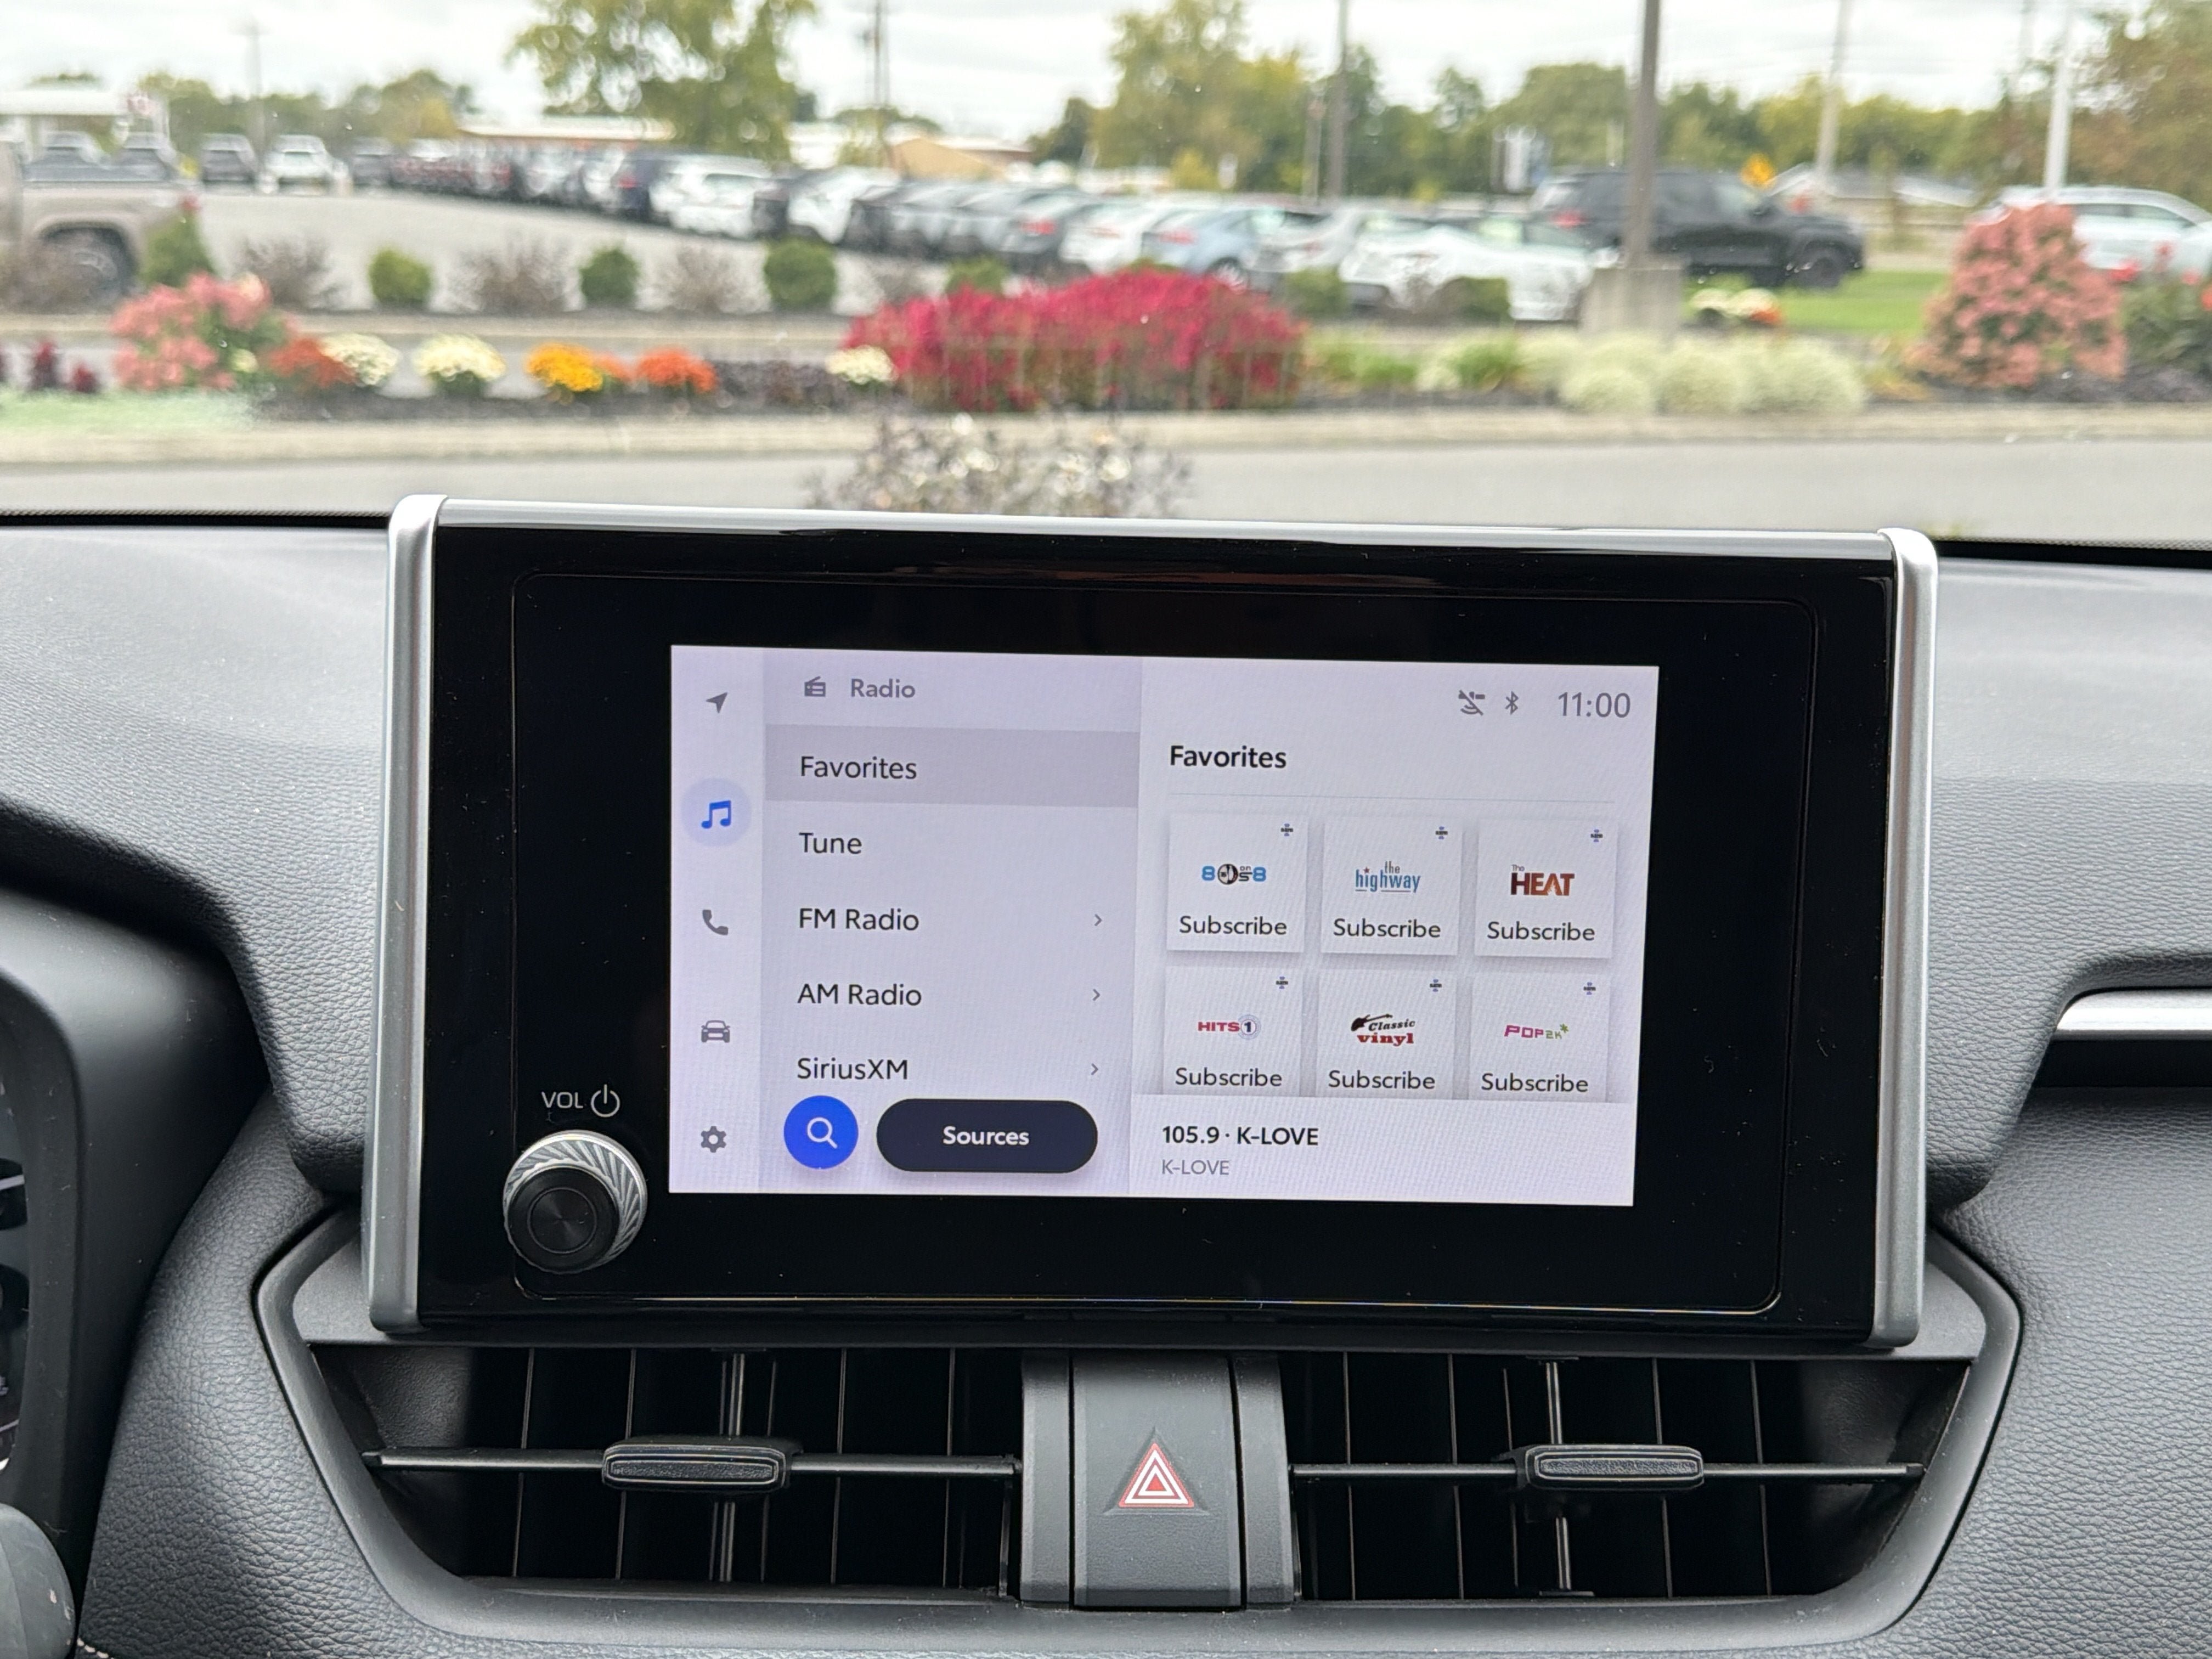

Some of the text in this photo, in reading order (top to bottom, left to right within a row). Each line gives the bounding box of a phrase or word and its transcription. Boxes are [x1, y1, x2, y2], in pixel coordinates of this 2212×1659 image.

[850, 678, 916, 699] Radio
[1558, 691, 1632, 719] 11:00
[800, 755, 917, 780] Favorites
[1170, 744, 1287, 769] Favorites
[798, 832, 862, 855] Tune
[1384, 861, 1401, 874] the
[1355, 868, 1421, 893] highway
[1510, 872, 1575, 896] HEAT
[799, 907, 919, 932] FM Radio
[1179, 915, 1288, 936] Subscribe
[1333, 917, 1442, 939] Subscribe
[1487, 920, 1595, 941] Subscribe
[797, 983, 922, 1007] AM Radio
[1198, 1022, 1240, 1031] HITS
[1368, 1019, 1415, 1031] Classic
[1357, 1032, 1414, 1046] vinyl
[797, 1057, 908, 1081] SiriusXM
[1175, 1066, 1283, 1088] Subscribe
[1328, 1069, 1436, 1091] Subscribe
[1481, 1072, 1589, 1093] Subscribe
[541, 1091, 584, 1109] VOL
[943, 1125, 1030, 1146] Sources
[1162, 1125, 1220, 1144] 105.9
[1237, 1126, 1319, 1147] K-LOVE
[1161, 1159, 1230, 1176] K-LOVE
